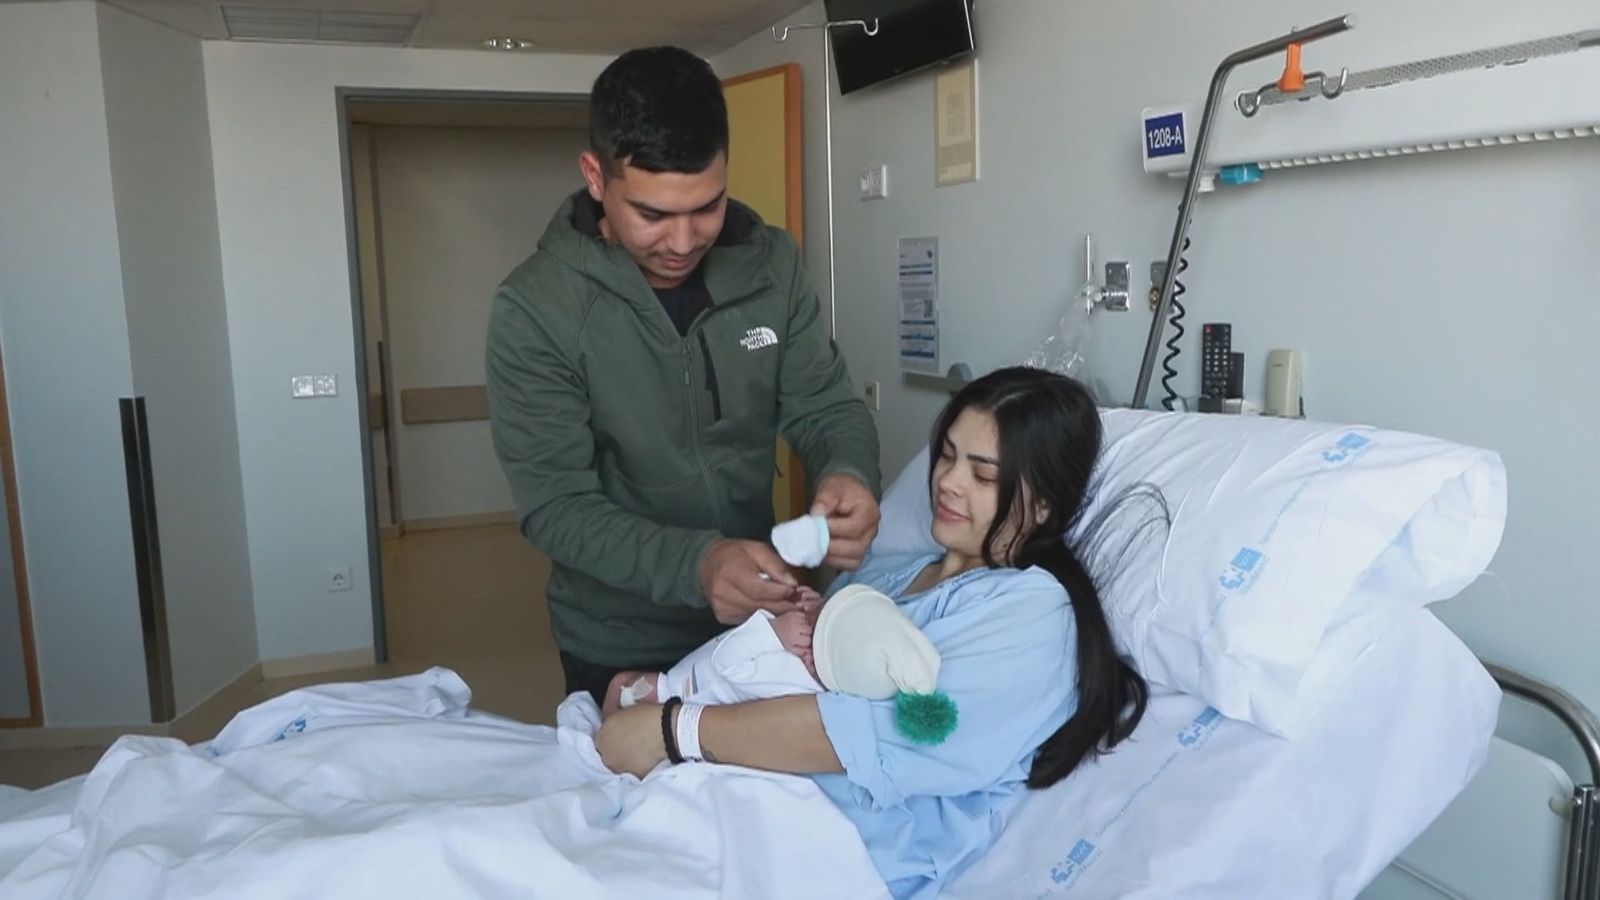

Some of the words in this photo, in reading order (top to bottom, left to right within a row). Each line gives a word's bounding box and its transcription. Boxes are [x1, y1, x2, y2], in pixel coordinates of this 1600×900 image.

[1148, 125, 1183, 149] 1208-A
[746, 327, 761, 337] THE
[740, 335, 763, 346] NORTH
